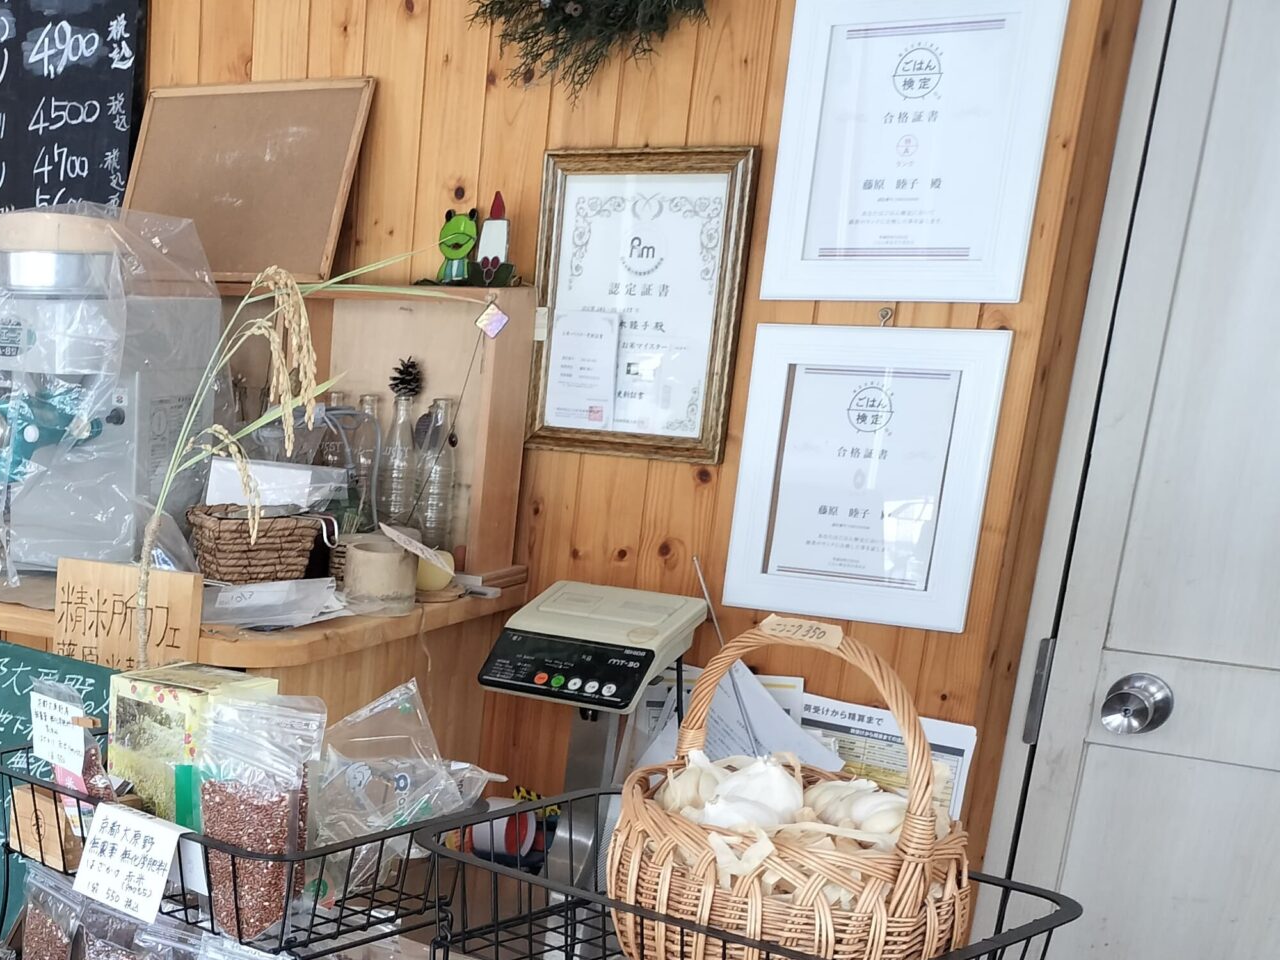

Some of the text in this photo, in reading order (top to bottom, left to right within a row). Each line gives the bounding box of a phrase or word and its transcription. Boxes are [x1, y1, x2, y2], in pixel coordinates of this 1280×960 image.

[901, 59, 937, 74] ごはん
[901, 77, 931, 92] 検定
[28, 96, 101, 135] 4500
[883, 110, 939, 125] 合格証書
[33, 143, 89, 184] 4700
[608, 282, 670, 298] 認定証書
[855, 396, 888, 410] ごはん
[855, 412, 884, 426] 検定
[837, 446, 889, 461] 合格証書
[803, 625, 827, 641] 350
[803, 703, 885, 726] 荷受けから精算まで
